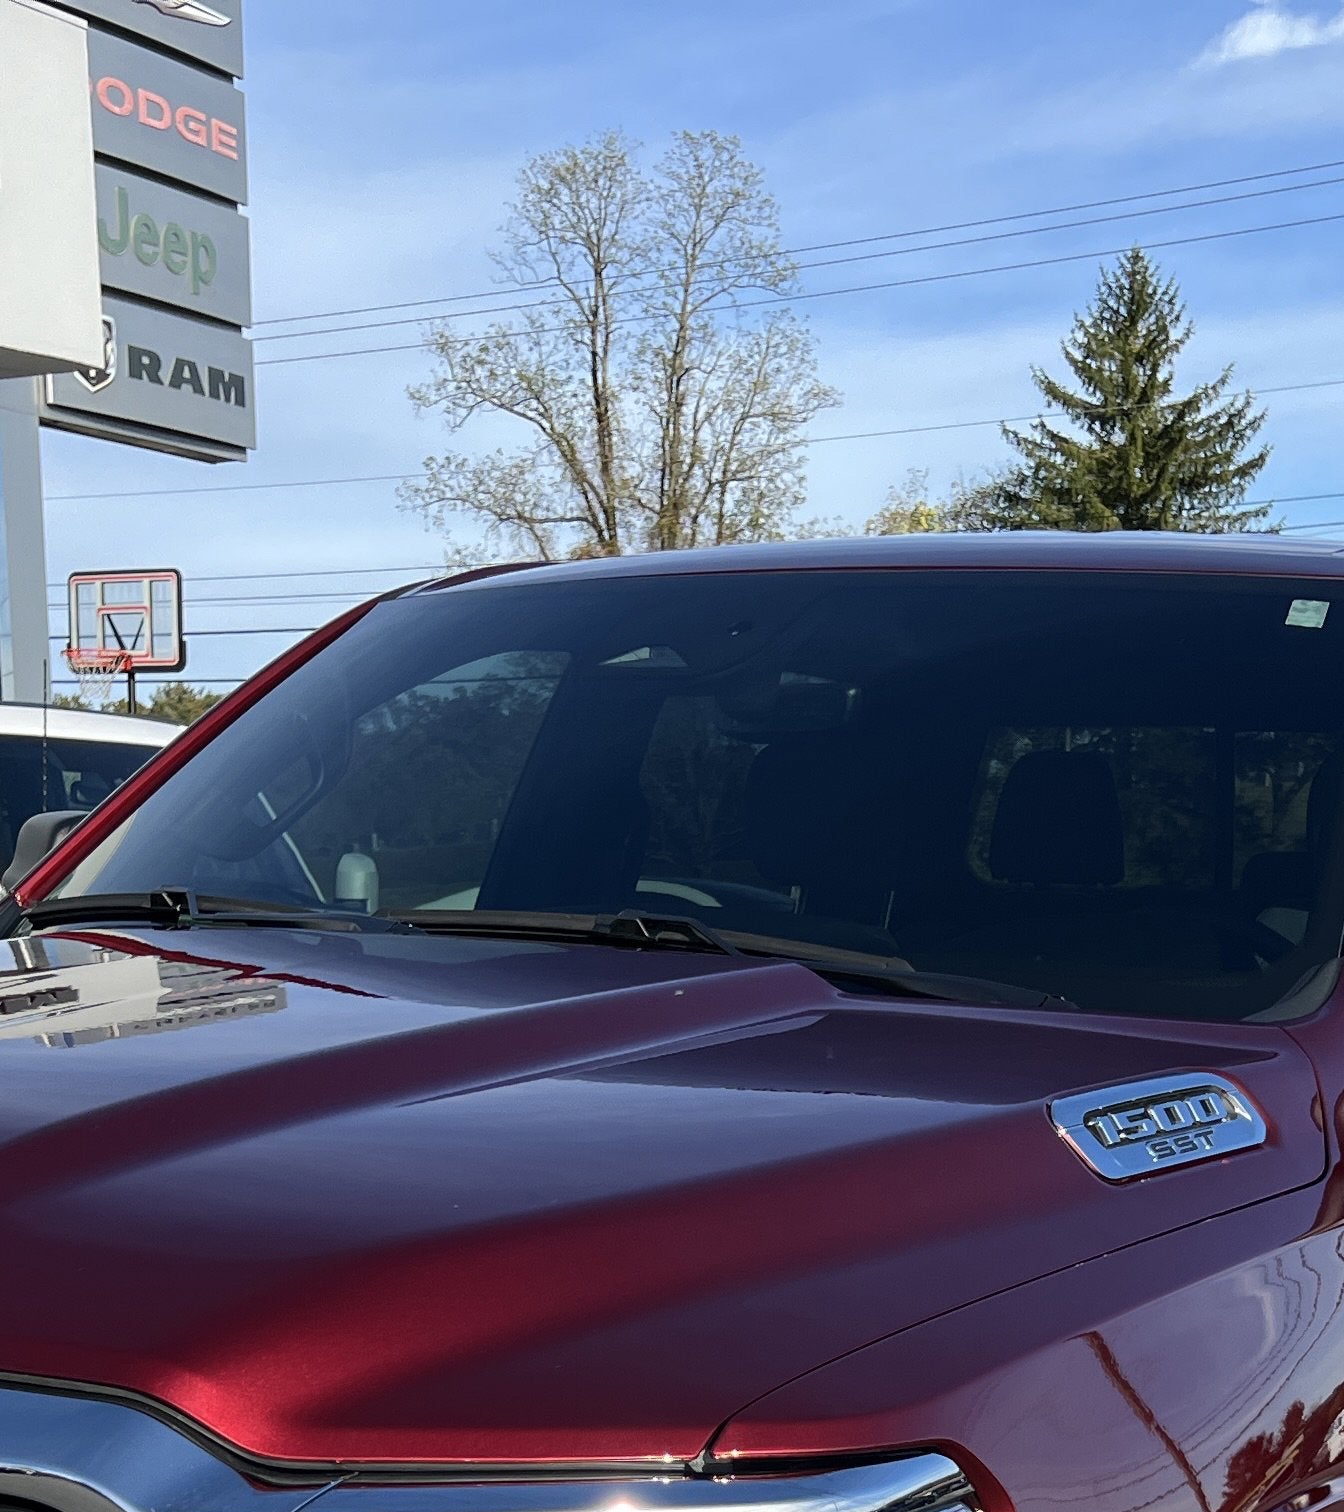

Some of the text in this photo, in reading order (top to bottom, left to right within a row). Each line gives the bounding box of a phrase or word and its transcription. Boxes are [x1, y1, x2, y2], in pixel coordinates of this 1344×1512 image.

[89, 75, 238, 161] ODGE
[98, 186, 217, 295] Jeep
[128, 344, 246, 408] RAM
[1088, 1093, 1230, 1147] 1500
